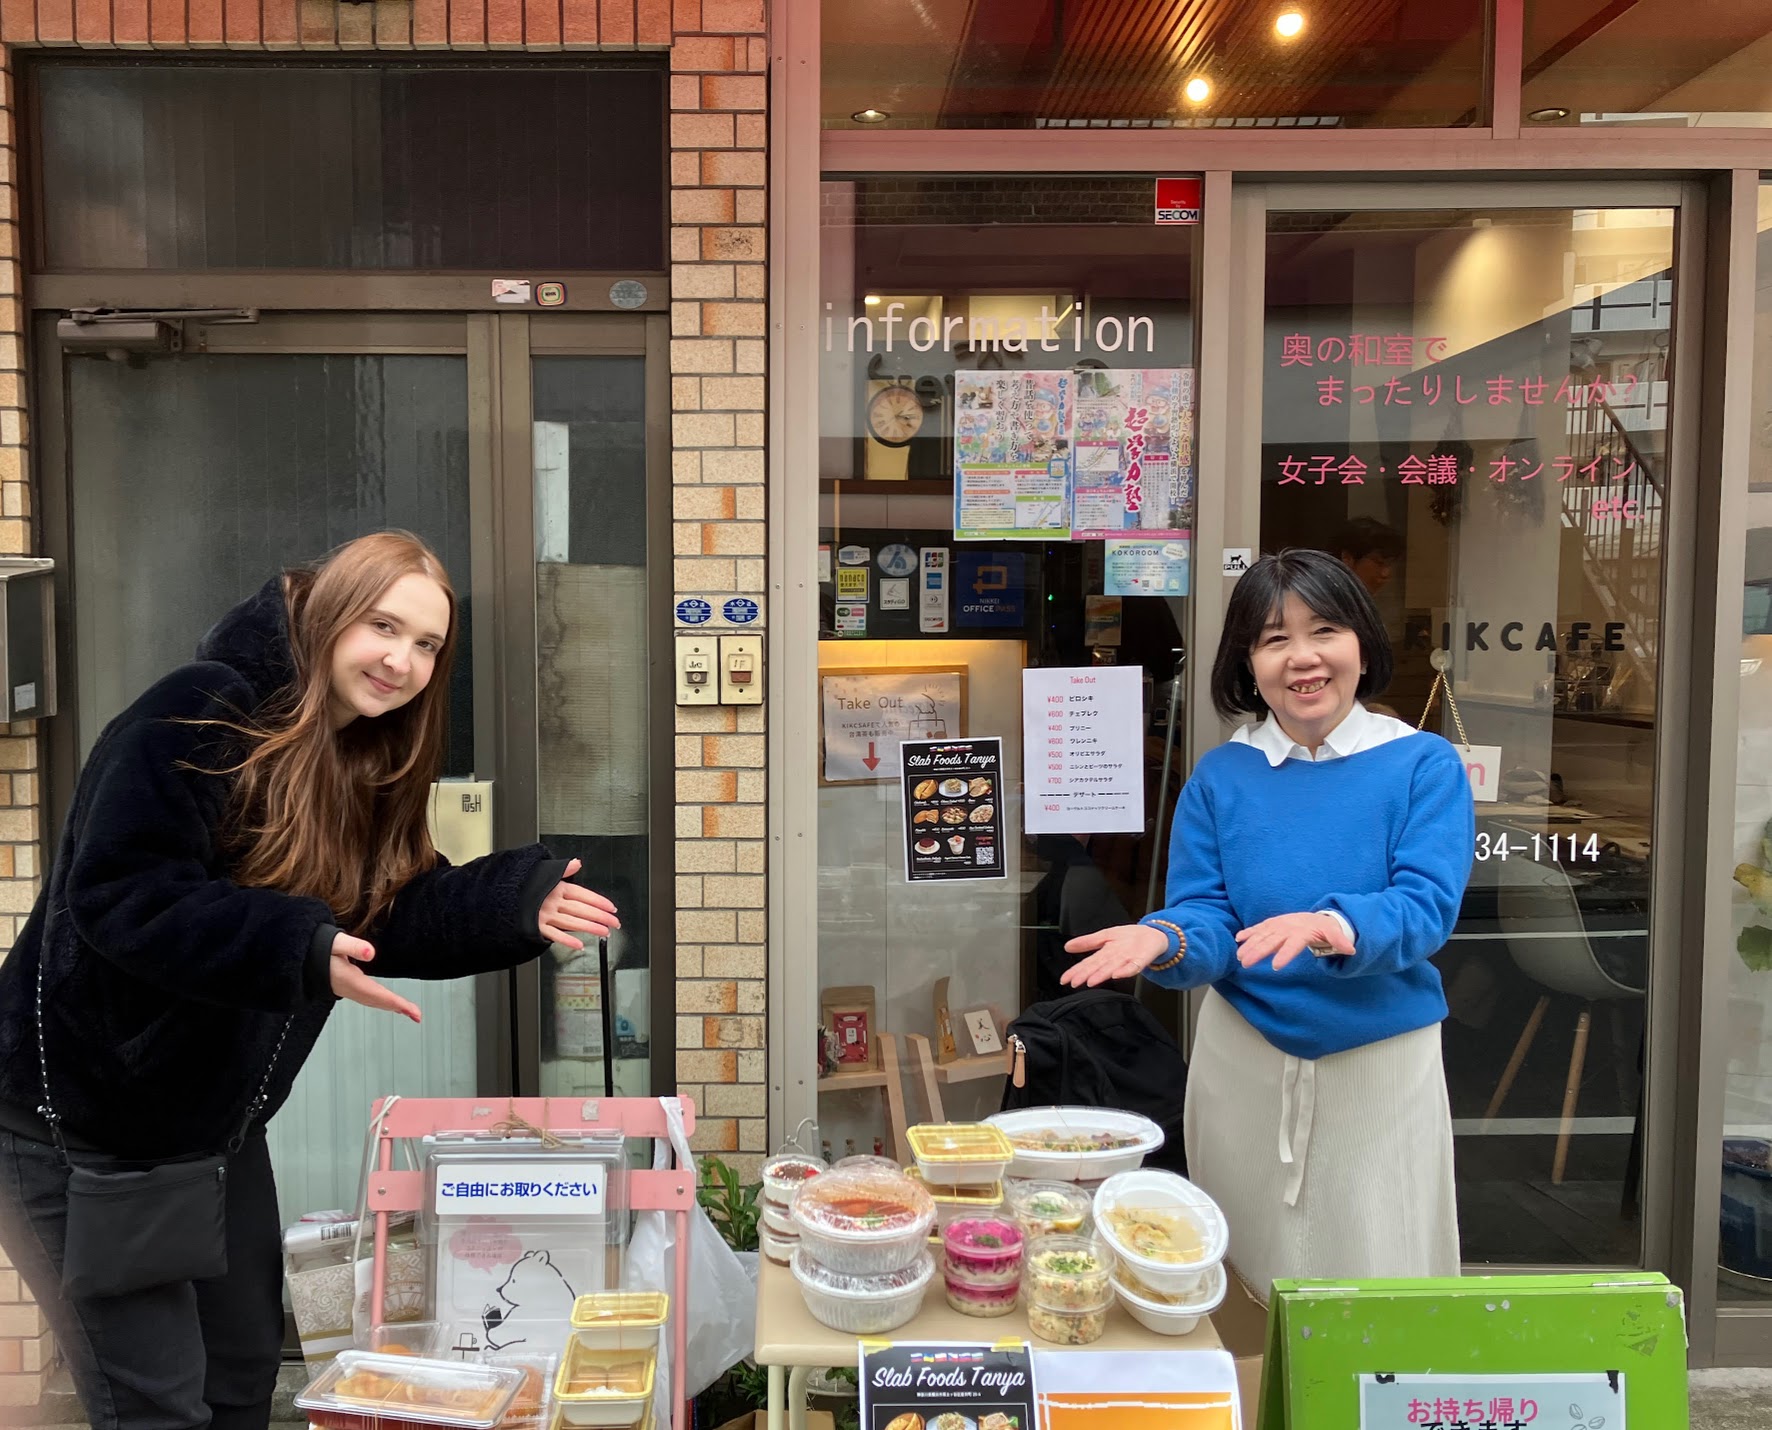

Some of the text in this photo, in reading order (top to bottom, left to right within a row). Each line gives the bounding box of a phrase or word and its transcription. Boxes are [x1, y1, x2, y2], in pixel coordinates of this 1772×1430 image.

[1158, 210, 1198, 220] SECOM
[825, 303, 1154, 352] information
[1280, 332, 1447, 367] 奥の和室で
[1316, 374, 1639, 406] まったりしませんか?
[1277, 454, 1636, 485] 女子会・会議・オンライン
[1591, 497, 1645, 521] etc.
[963, 605, 995, 613] OFFICE
[1069, 676, 1097, 684] Take Out
[838, 697, 903, 710] Take Out
[907, 752, 996, 768] Slab Foods Tanya
[441, 1181, 598, 1199] ご自由にお取りください
[871, 1366, 1026, 1396] Slab Foods Tanya
[1406, 1397, 1539, 1423] お持ち帰り
